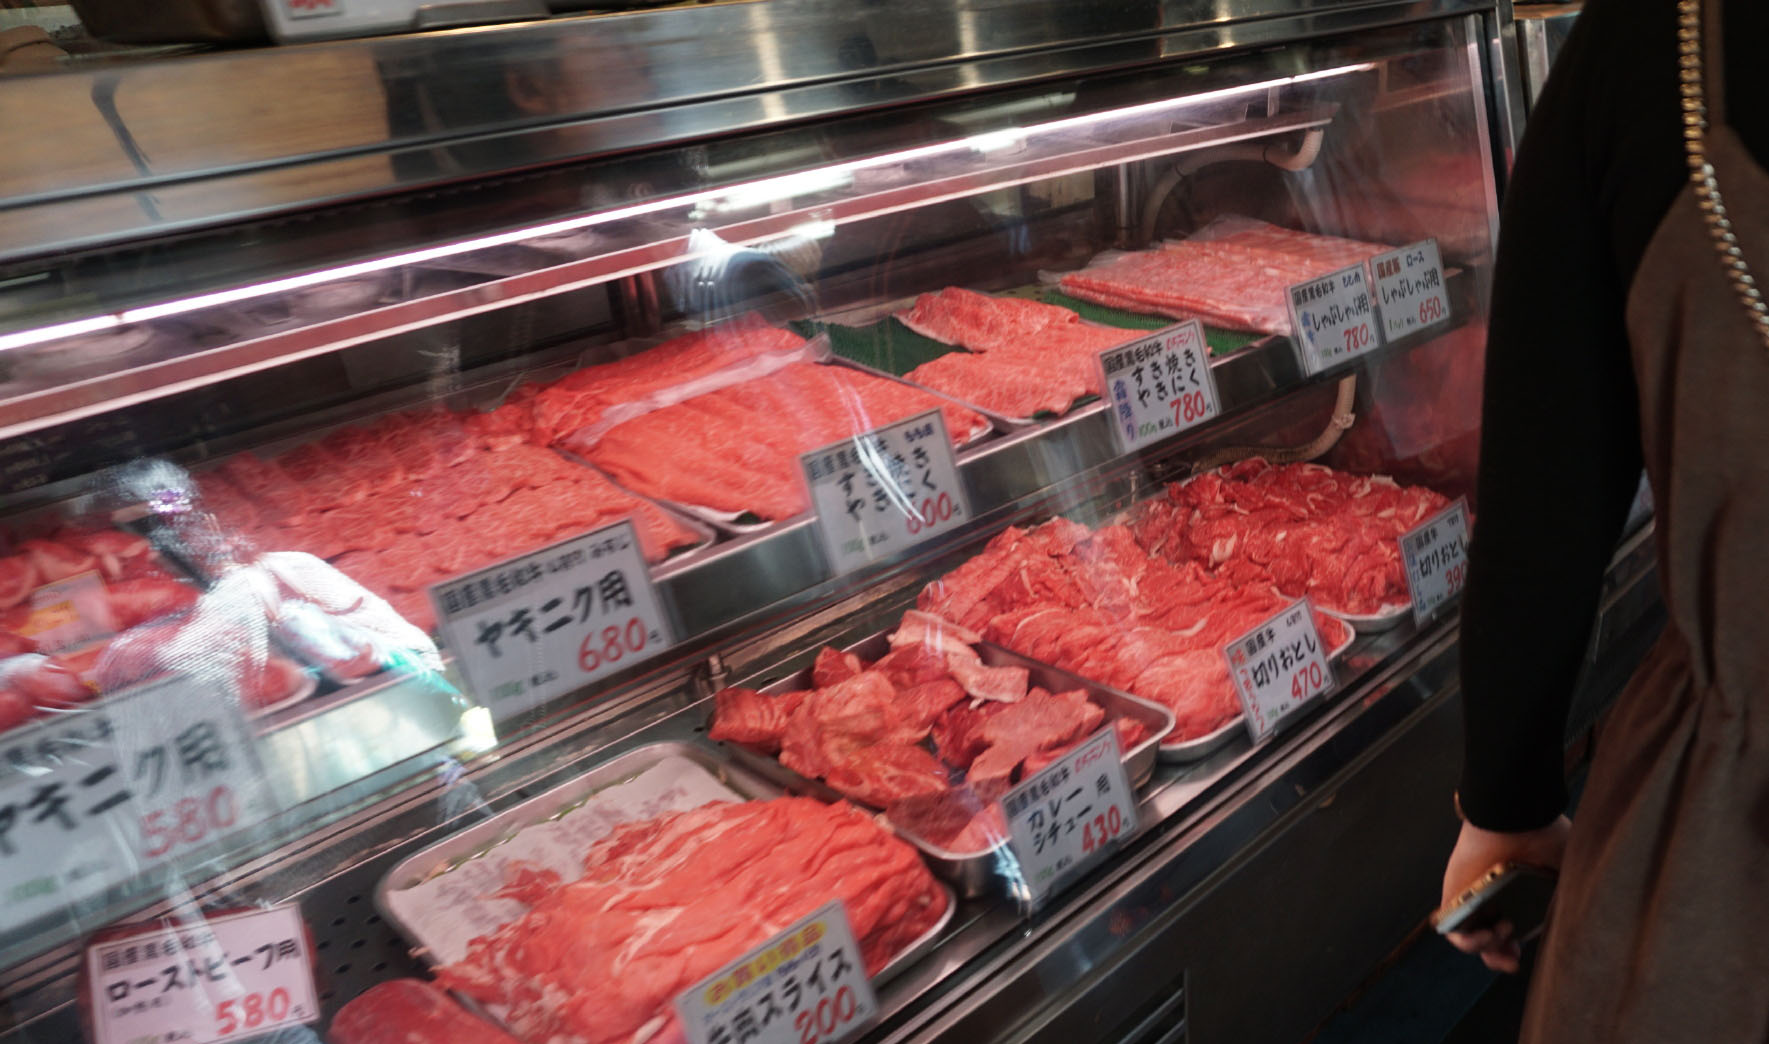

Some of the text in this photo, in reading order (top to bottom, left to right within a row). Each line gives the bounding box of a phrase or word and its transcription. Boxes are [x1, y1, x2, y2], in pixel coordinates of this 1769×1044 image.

[1406, 251, 1424, 268] ロース
[1381, 267, 1440, 305] しゃぶしゃぶ用
[1312, 293, 1370, 332] しゃぶしゃぶ用
[1419, 296, 1441, 324] 650
[1344, 323, 1369, 352] 780
[1132, 349, 1196, 386] すき焼き
[1137, 368, 1200, 408] やきにく
[1170, 390, 1205, 427] 780
[907, 492, 952, 534] 600
[475, 569, 632, 658] ヤキニク用
[578, 617, 648, 672] 680
[1252, 634, 1316, 688] 切りおとし
[1291, 661, 1322, 699] 470
[140, 785, 240, 857] 580
[1027, 773, 1111, 832] カレー 用
[1033, 805, 1093, 856] シチュー
[1082, 804, 1121, 853] 430
[107, 939, 300, 1001] ローストビーフ用
[216, 987, 290, 1036] 580
[794, 985, 856, 1044] 200
